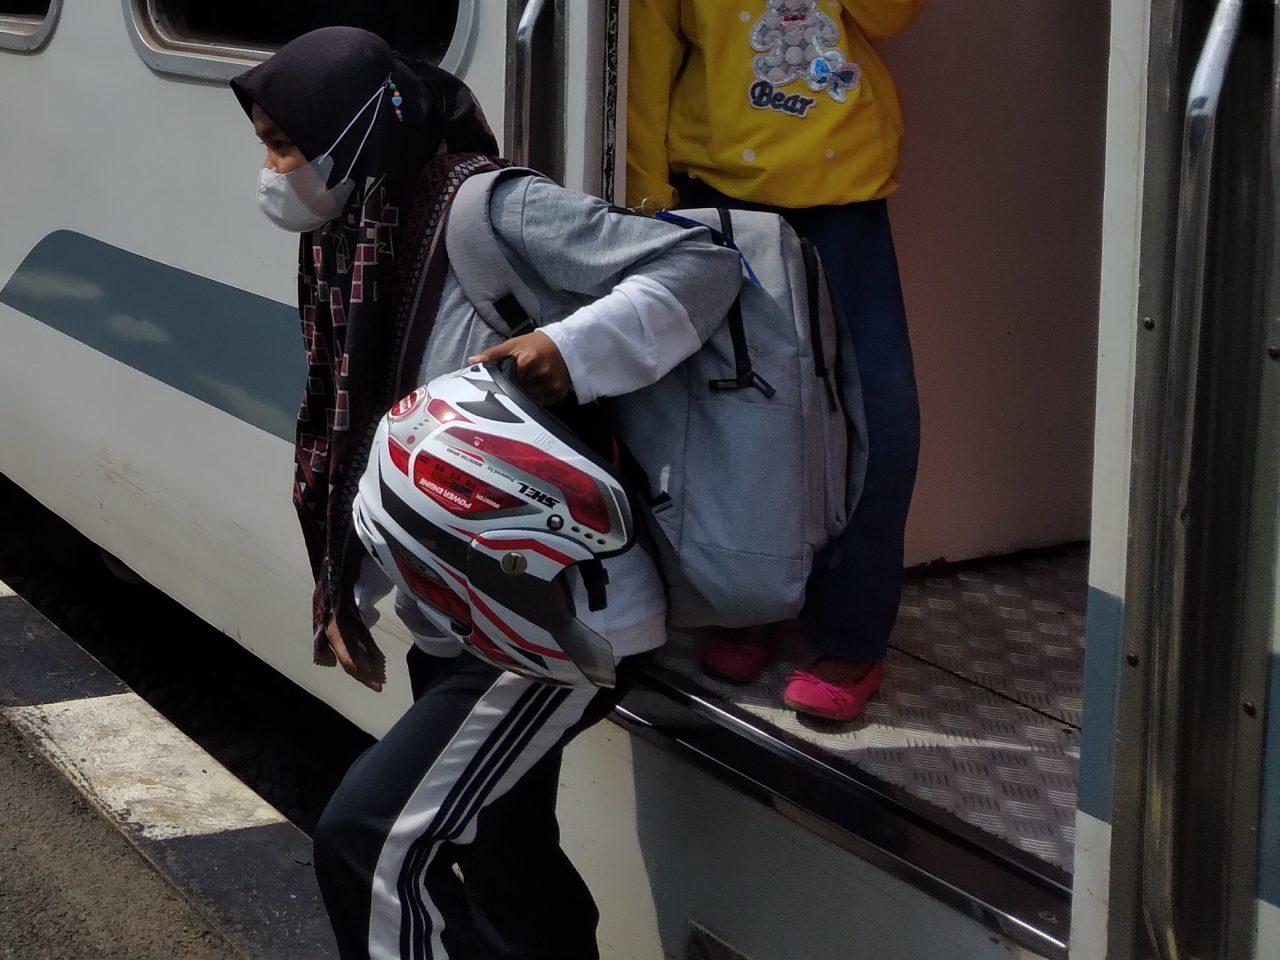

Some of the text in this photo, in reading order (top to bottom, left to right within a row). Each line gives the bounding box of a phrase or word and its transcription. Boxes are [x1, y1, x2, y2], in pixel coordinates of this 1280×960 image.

[750, 79, 815, 116] Bear
[418, 477, 472, 509] POWER ENGINE
